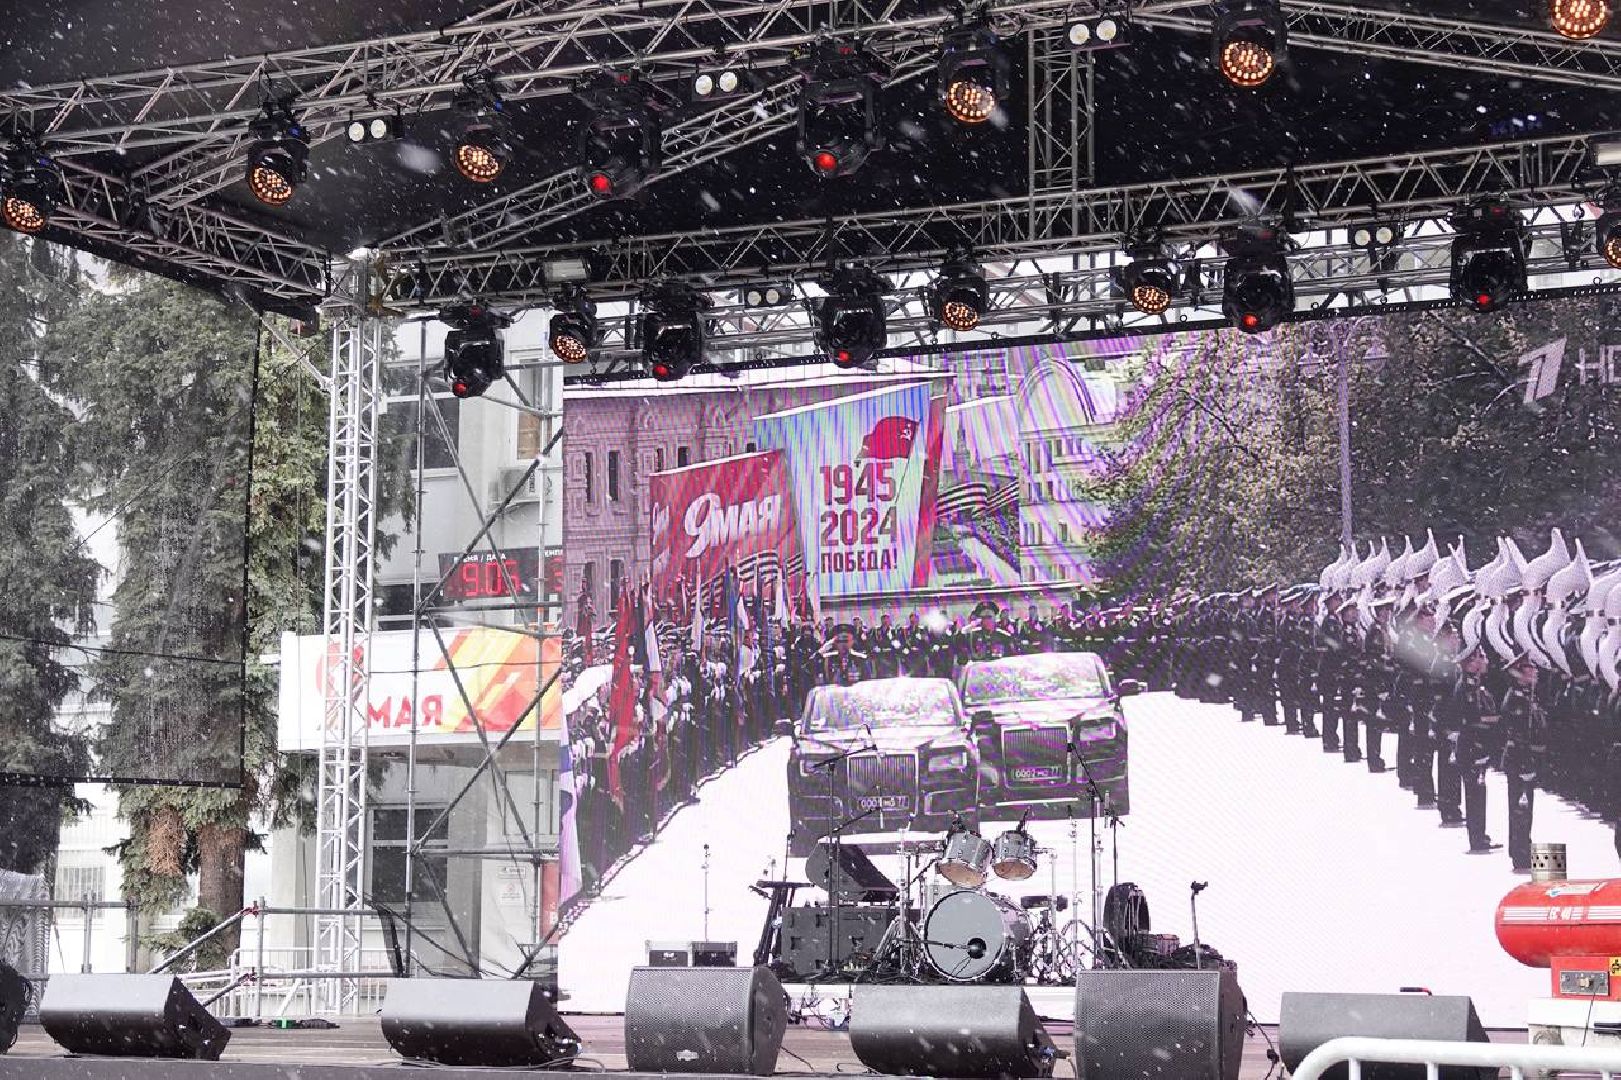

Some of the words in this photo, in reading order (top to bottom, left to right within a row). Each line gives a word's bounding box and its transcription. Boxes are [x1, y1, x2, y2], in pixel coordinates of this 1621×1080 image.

[820, 462, 896, 505] 1945
[684, 492, 721, 558] 9
[820, 506, 897, 546] 2024
[820, 549, 898, 574] ПОБЕДА!
[366, 694, 443, 729] МАЯ
